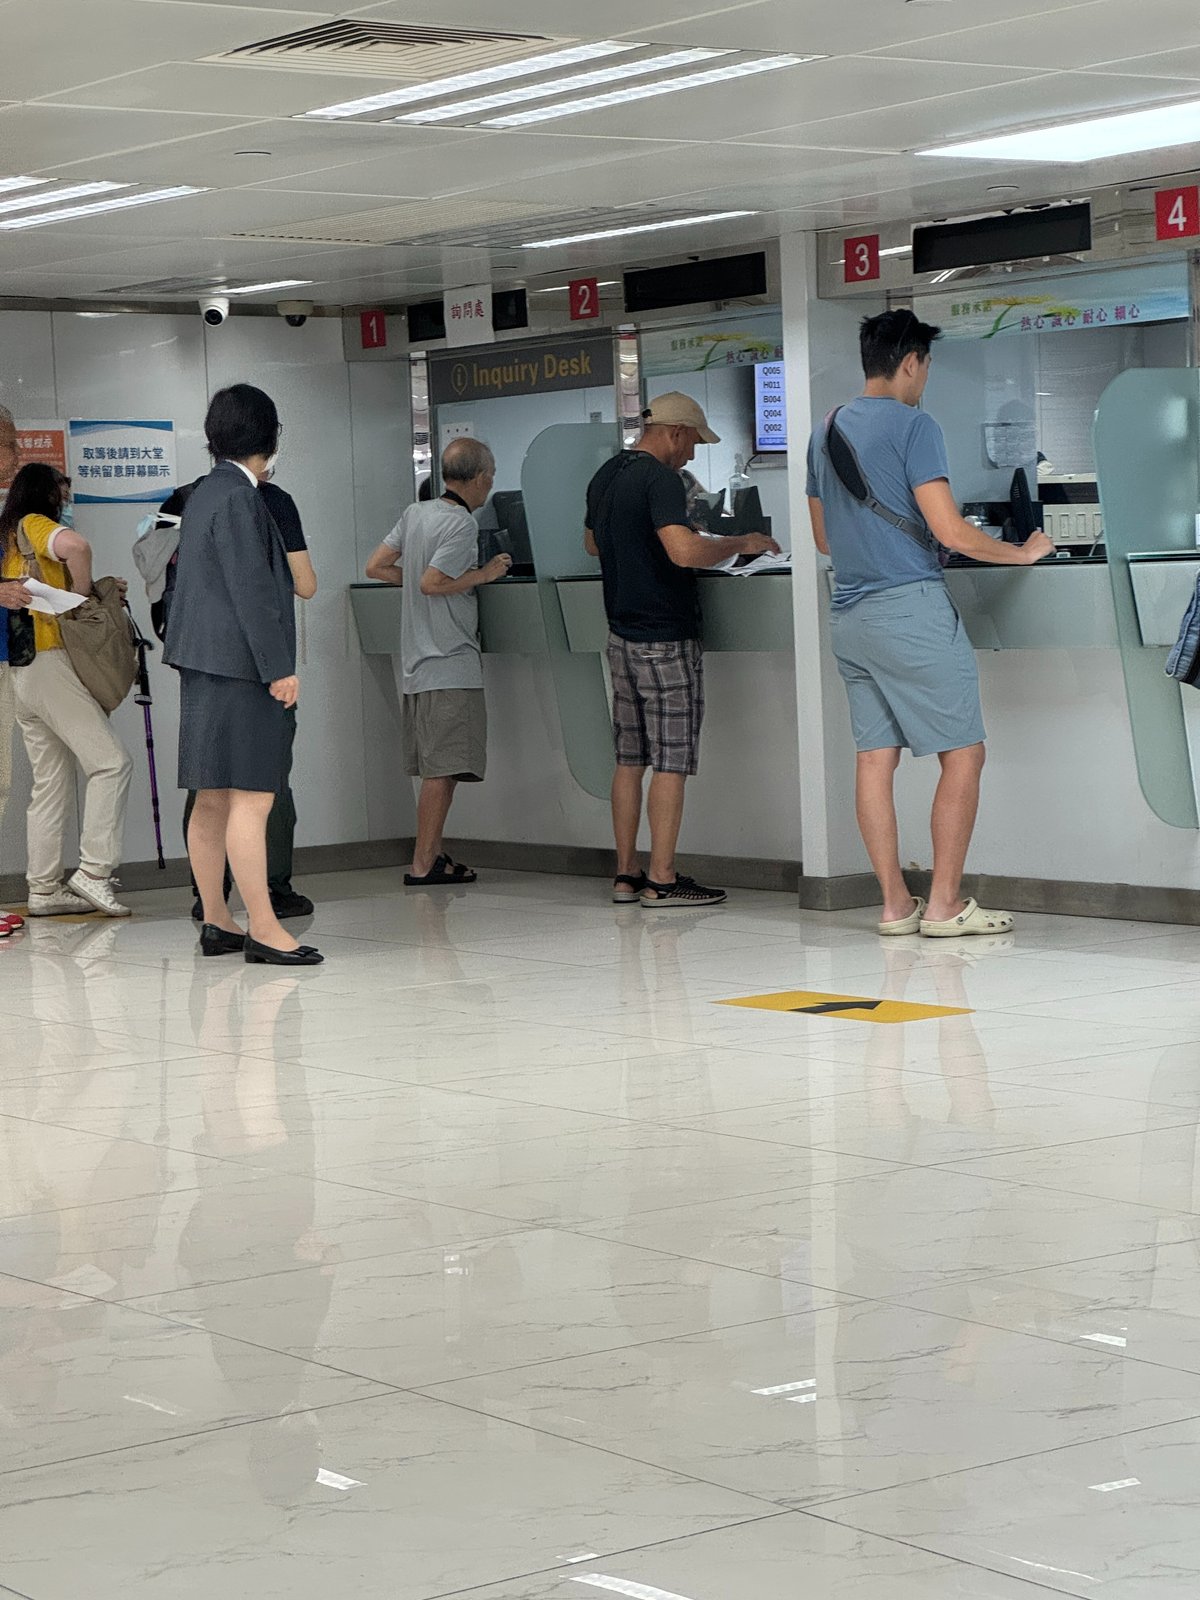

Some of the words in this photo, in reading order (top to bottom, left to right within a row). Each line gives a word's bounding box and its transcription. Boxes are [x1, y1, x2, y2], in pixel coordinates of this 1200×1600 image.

[1167, 195, 1188, 232] 4
[854, 243, 870, 277] 3
[451, 300, 485, 319] 詢問處
[577, 285, 592, 315] 2
[1082, 308, 1108, 325] 耐心
[1114, 303, 1141, 321] 細心
[370, 317, 379, 343] 1
[472, 358, 538, 389] Inquiry
[544, 350, 592, 380] Desk
[762, 366, 781, 376] Q005
[763, 381, 781, 389] H011
[763, 395, 782, 403] B004
[763, 423, 782, 433] Q002
[82, 447, 164, 460] 取籌後請到大堂
[77, 464, 171, 478] 等候留意屏幕顯示
